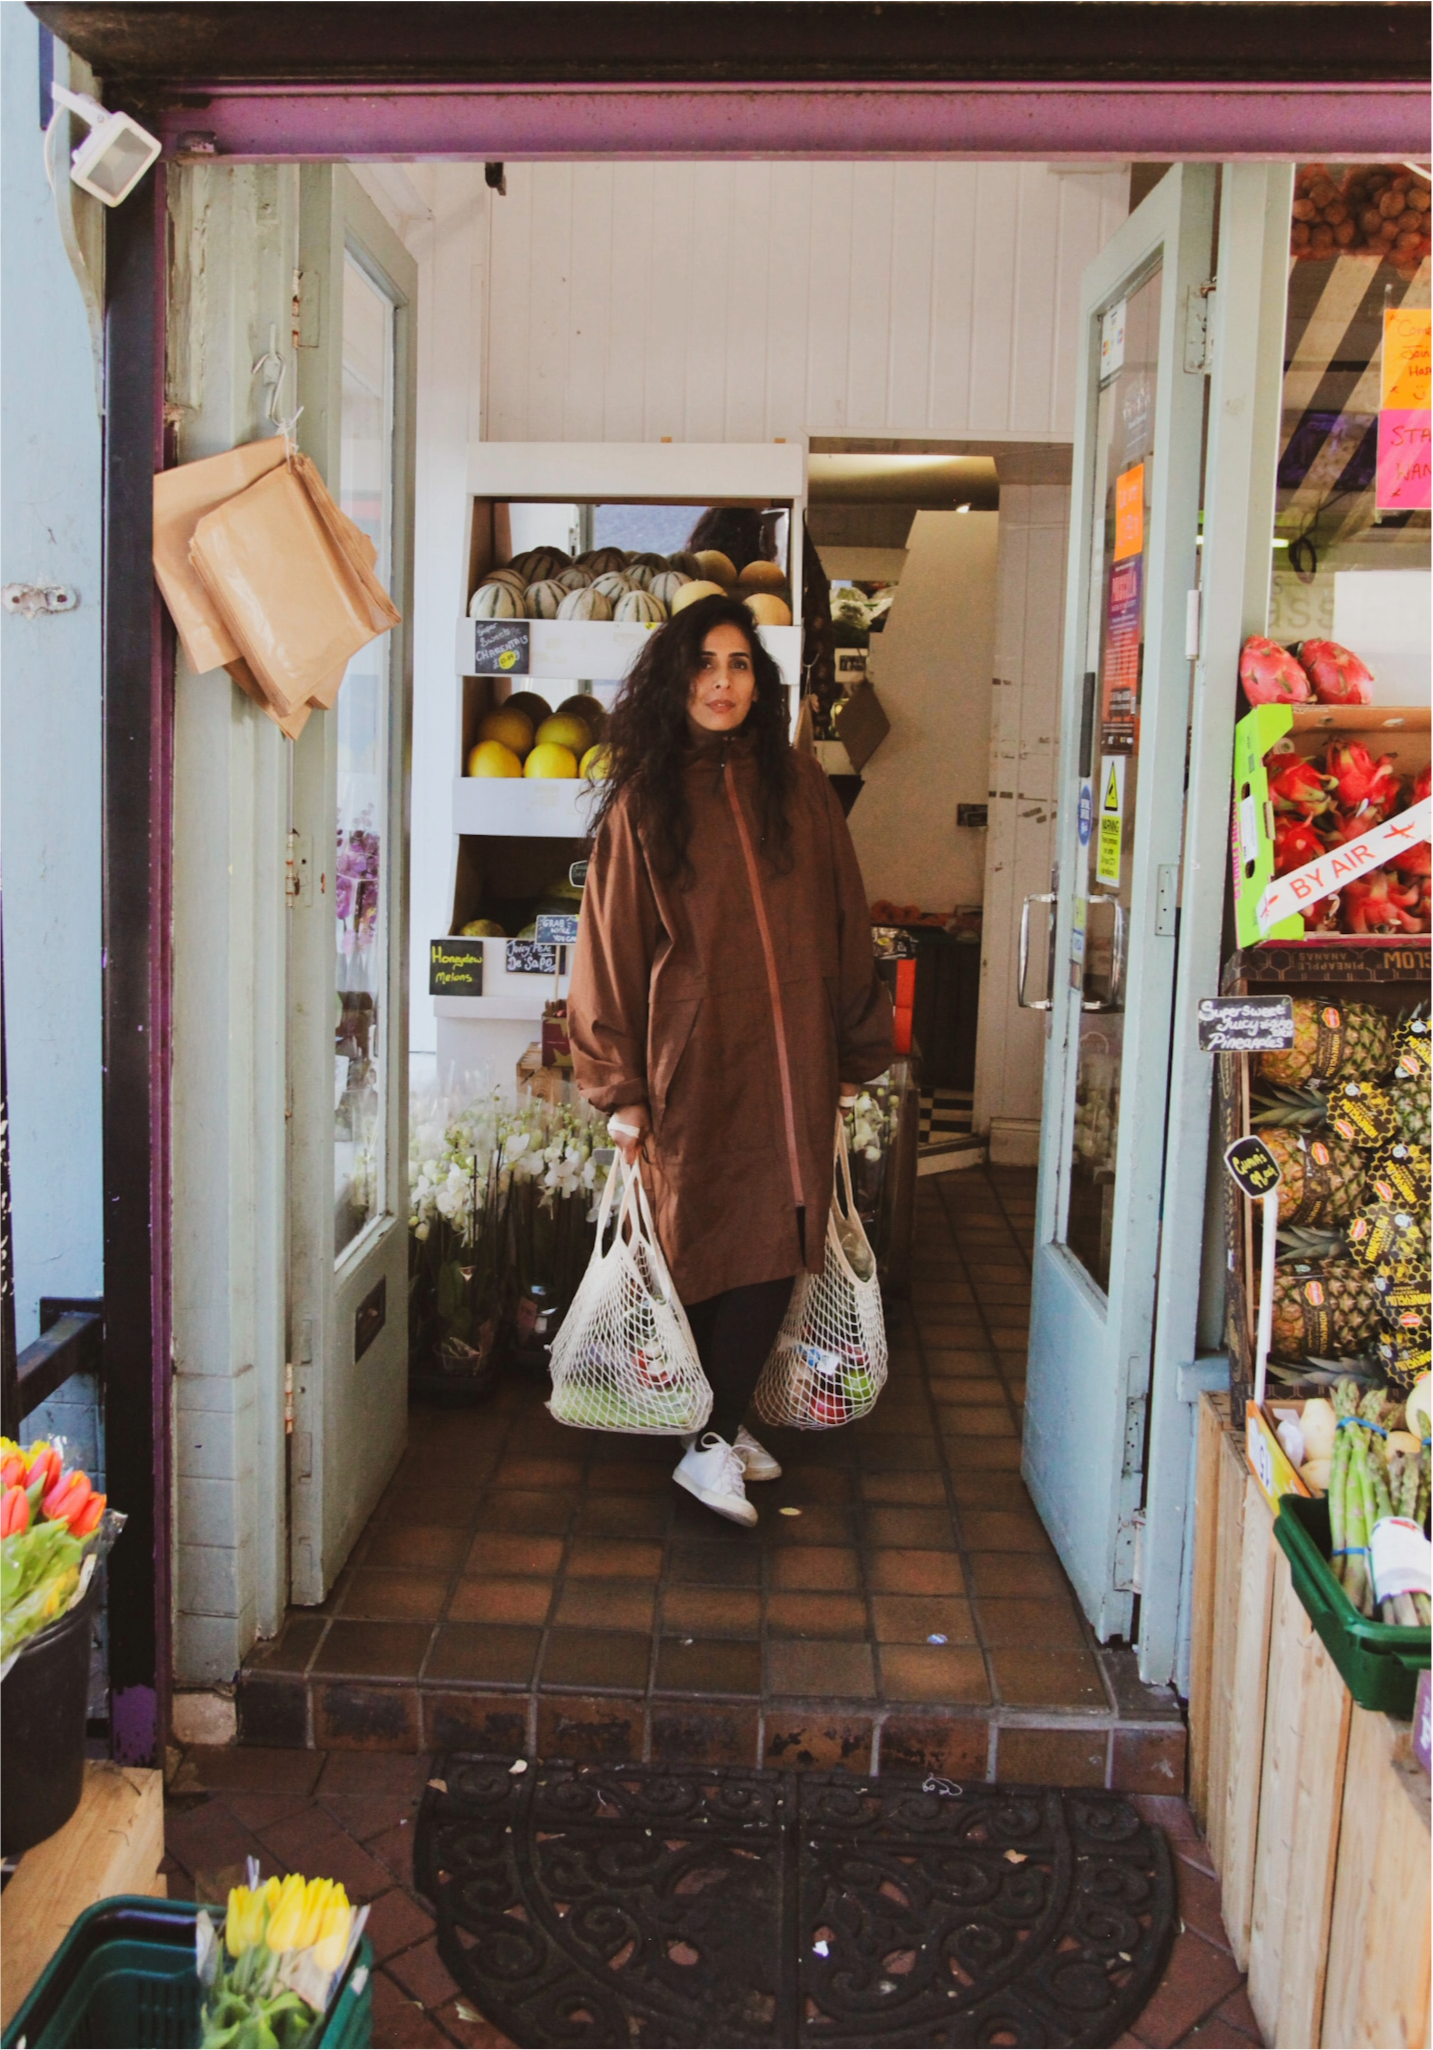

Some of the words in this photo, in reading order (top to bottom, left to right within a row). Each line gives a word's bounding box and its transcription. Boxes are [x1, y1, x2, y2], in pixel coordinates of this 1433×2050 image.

[1288, 867, 1327, 900] BY
[1331, 844, 1377, 879] AIR
[542, 919, 565, 928] GRAB
[432, 946, 483, 970] Honeydew
[1298, 952, 1347, 961] ANANAS
[1298, 961, 1365, 970] PINEAPPLE
[1363, 1213, 1390, 1262] HONEYGLOW
